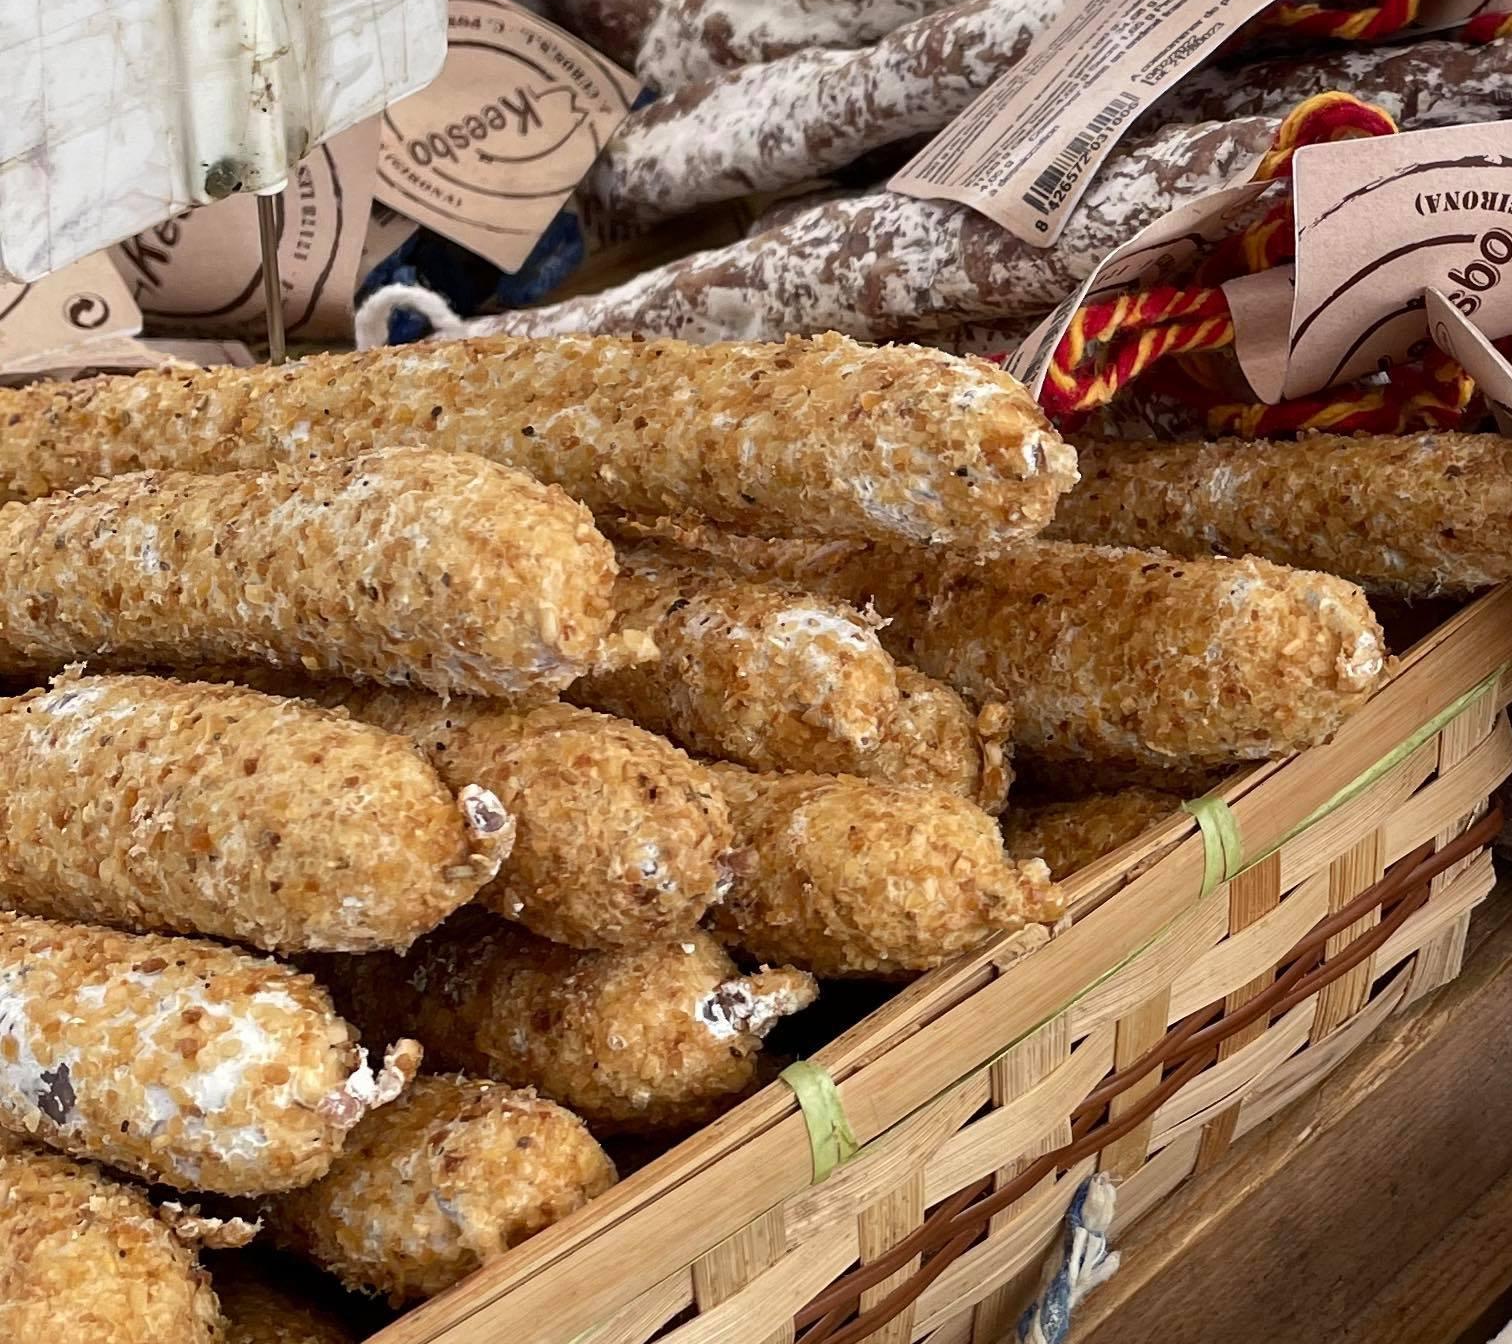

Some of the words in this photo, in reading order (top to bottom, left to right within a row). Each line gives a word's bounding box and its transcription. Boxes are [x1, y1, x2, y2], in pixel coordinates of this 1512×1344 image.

[406, 86, 544, 167] Keesbo
[1089, 93, 1139, 151] 031006
[1040, 150, 1090, 211] 426572
[1034, 219, 1048, 233] 8
